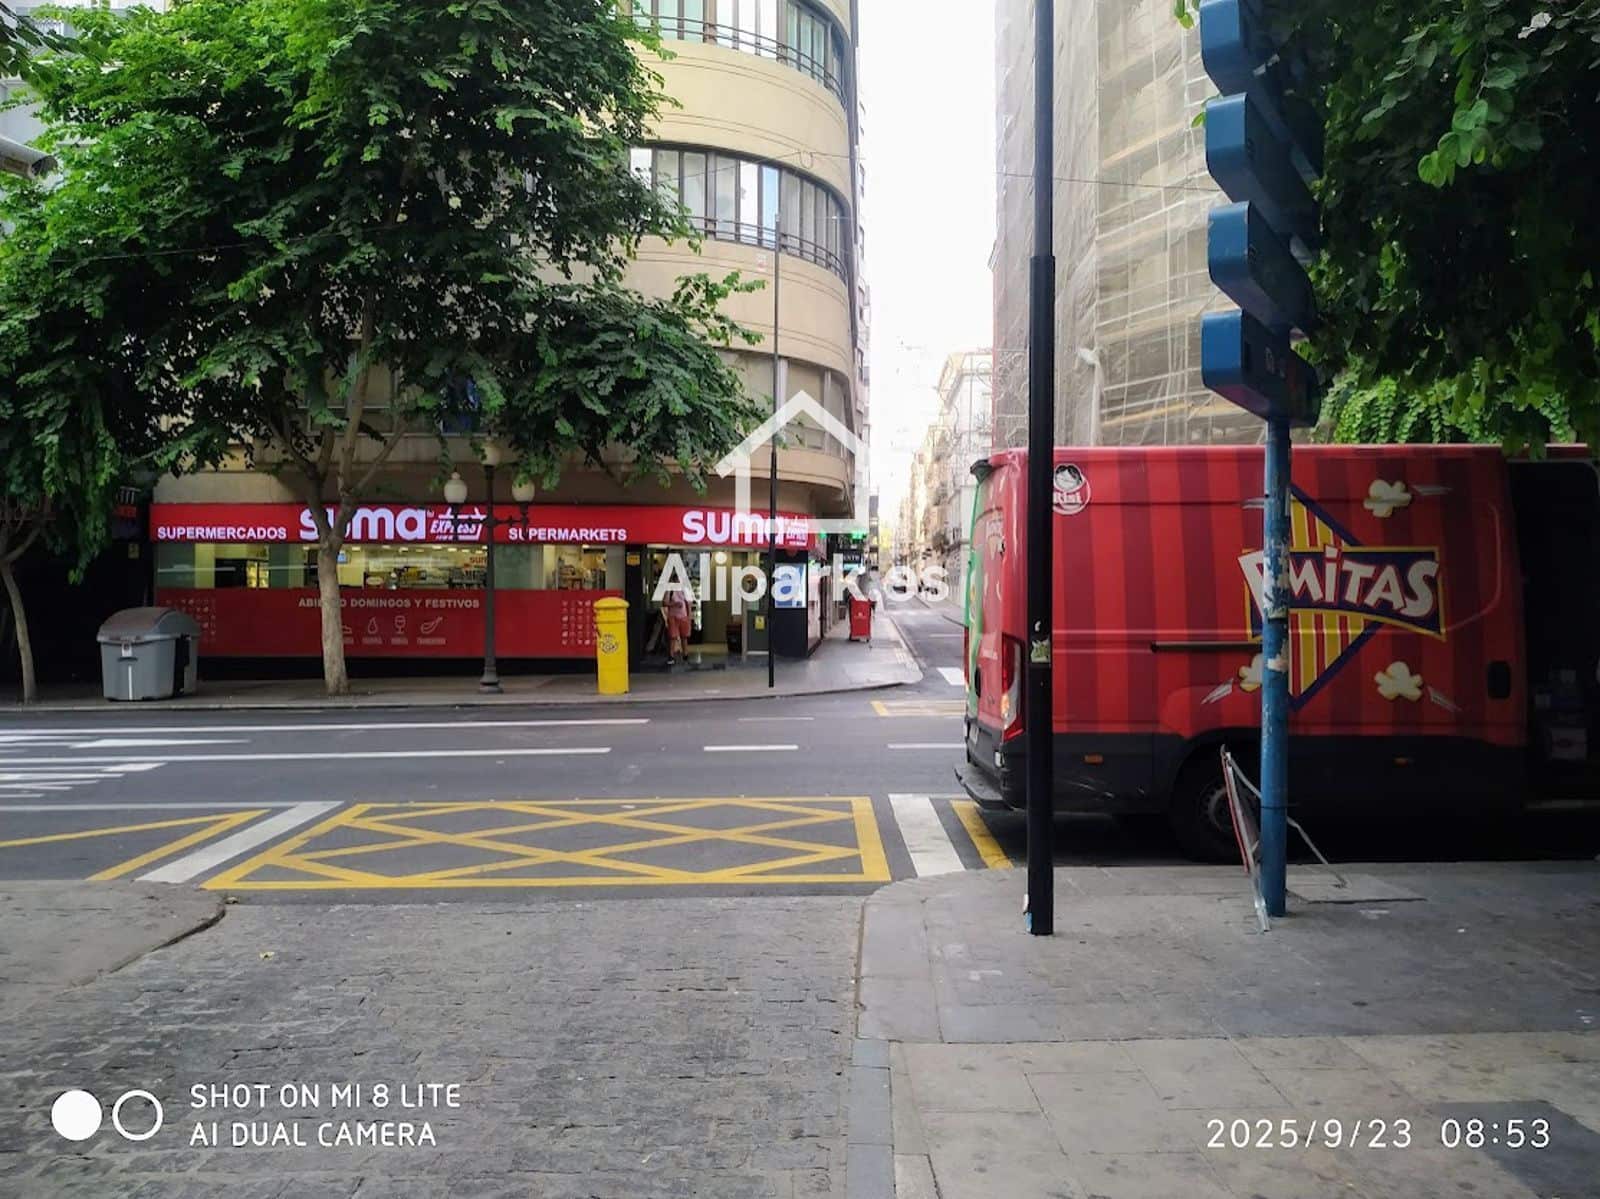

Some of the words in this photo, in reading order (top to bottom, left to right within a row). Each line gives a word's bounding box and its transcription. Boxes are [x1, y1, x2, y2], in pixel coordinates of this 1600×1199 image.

[157, 526, 287, 541] SUPERMERCADOS
[350, 598, 411, 608] DOMINGOS
[414, 598, 424, 608] Y
[425, 598, 480, 608] FESTIVOS
